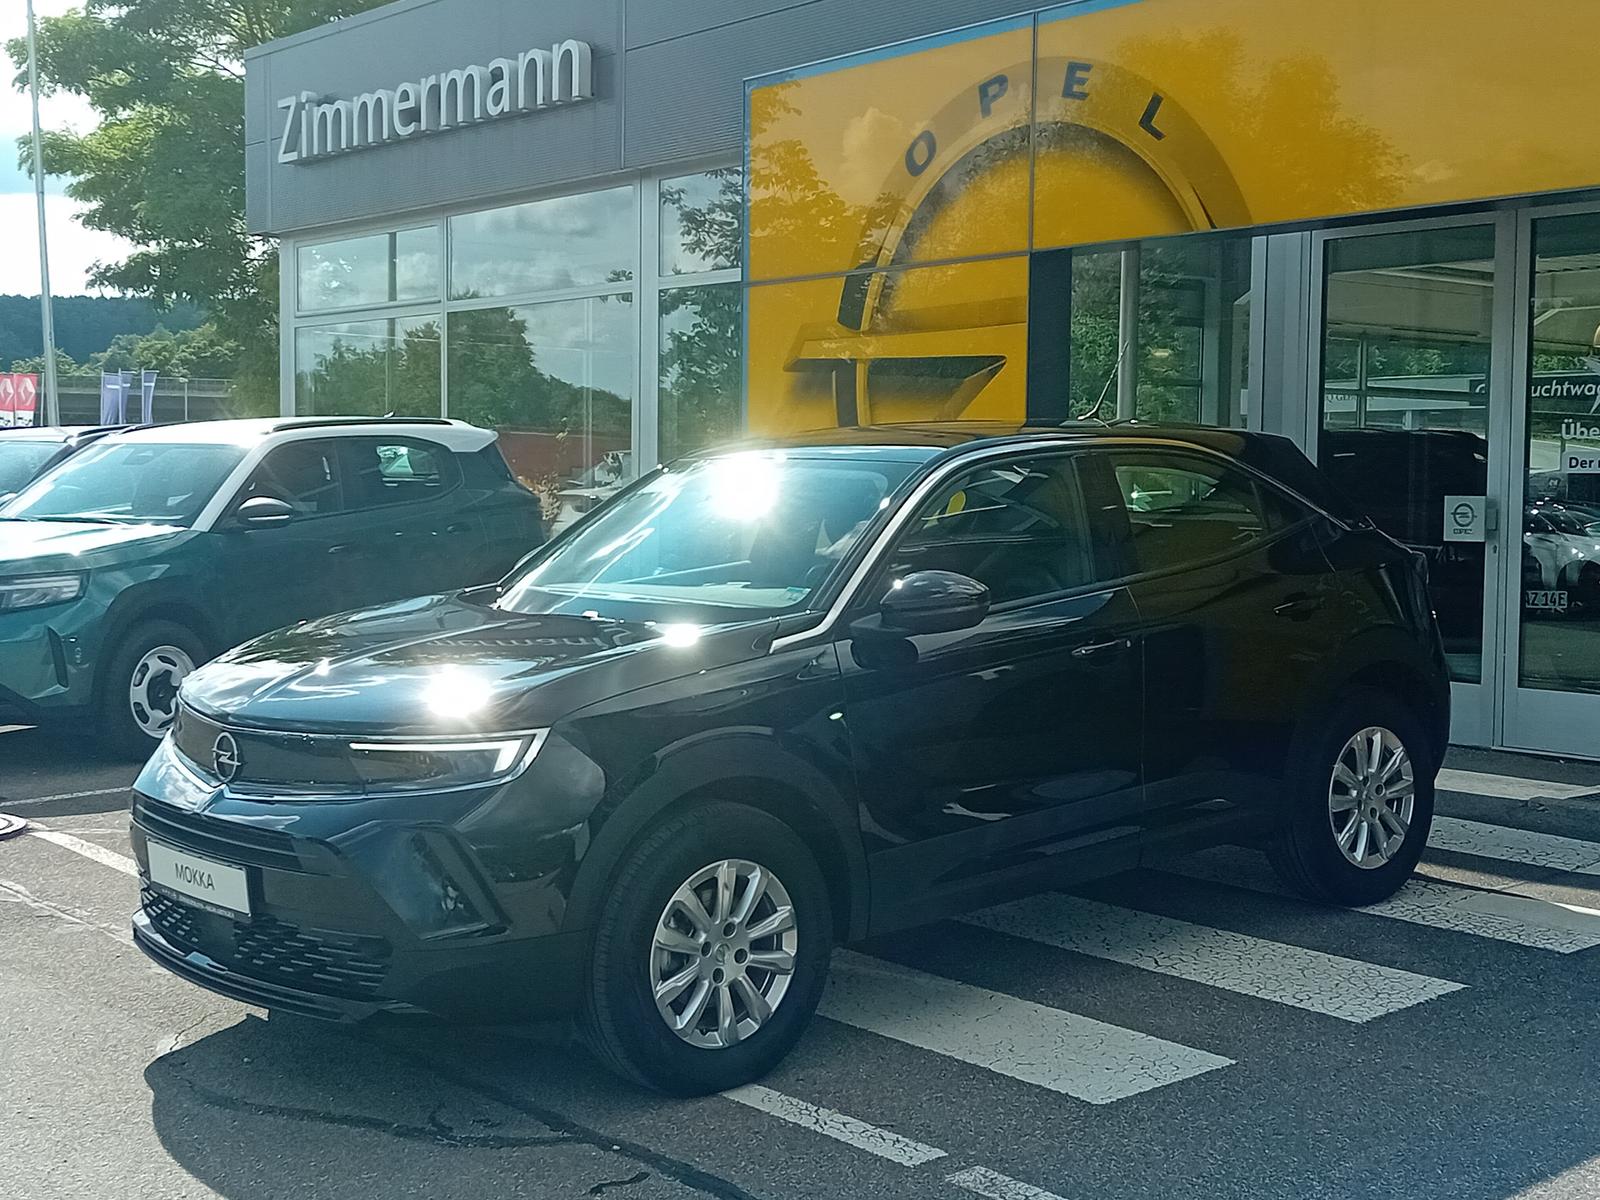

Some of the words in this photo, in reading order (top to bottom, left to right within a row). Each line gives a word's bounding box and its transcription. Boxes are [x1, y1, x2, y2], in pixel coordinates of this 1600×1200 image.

[277, 38, 594, 165] Zimmermann
[905, 61, 1166, 178] OPEL
[1569, 457, 1594, 468] Der
[175, 863, 215, 891] MOKKA
